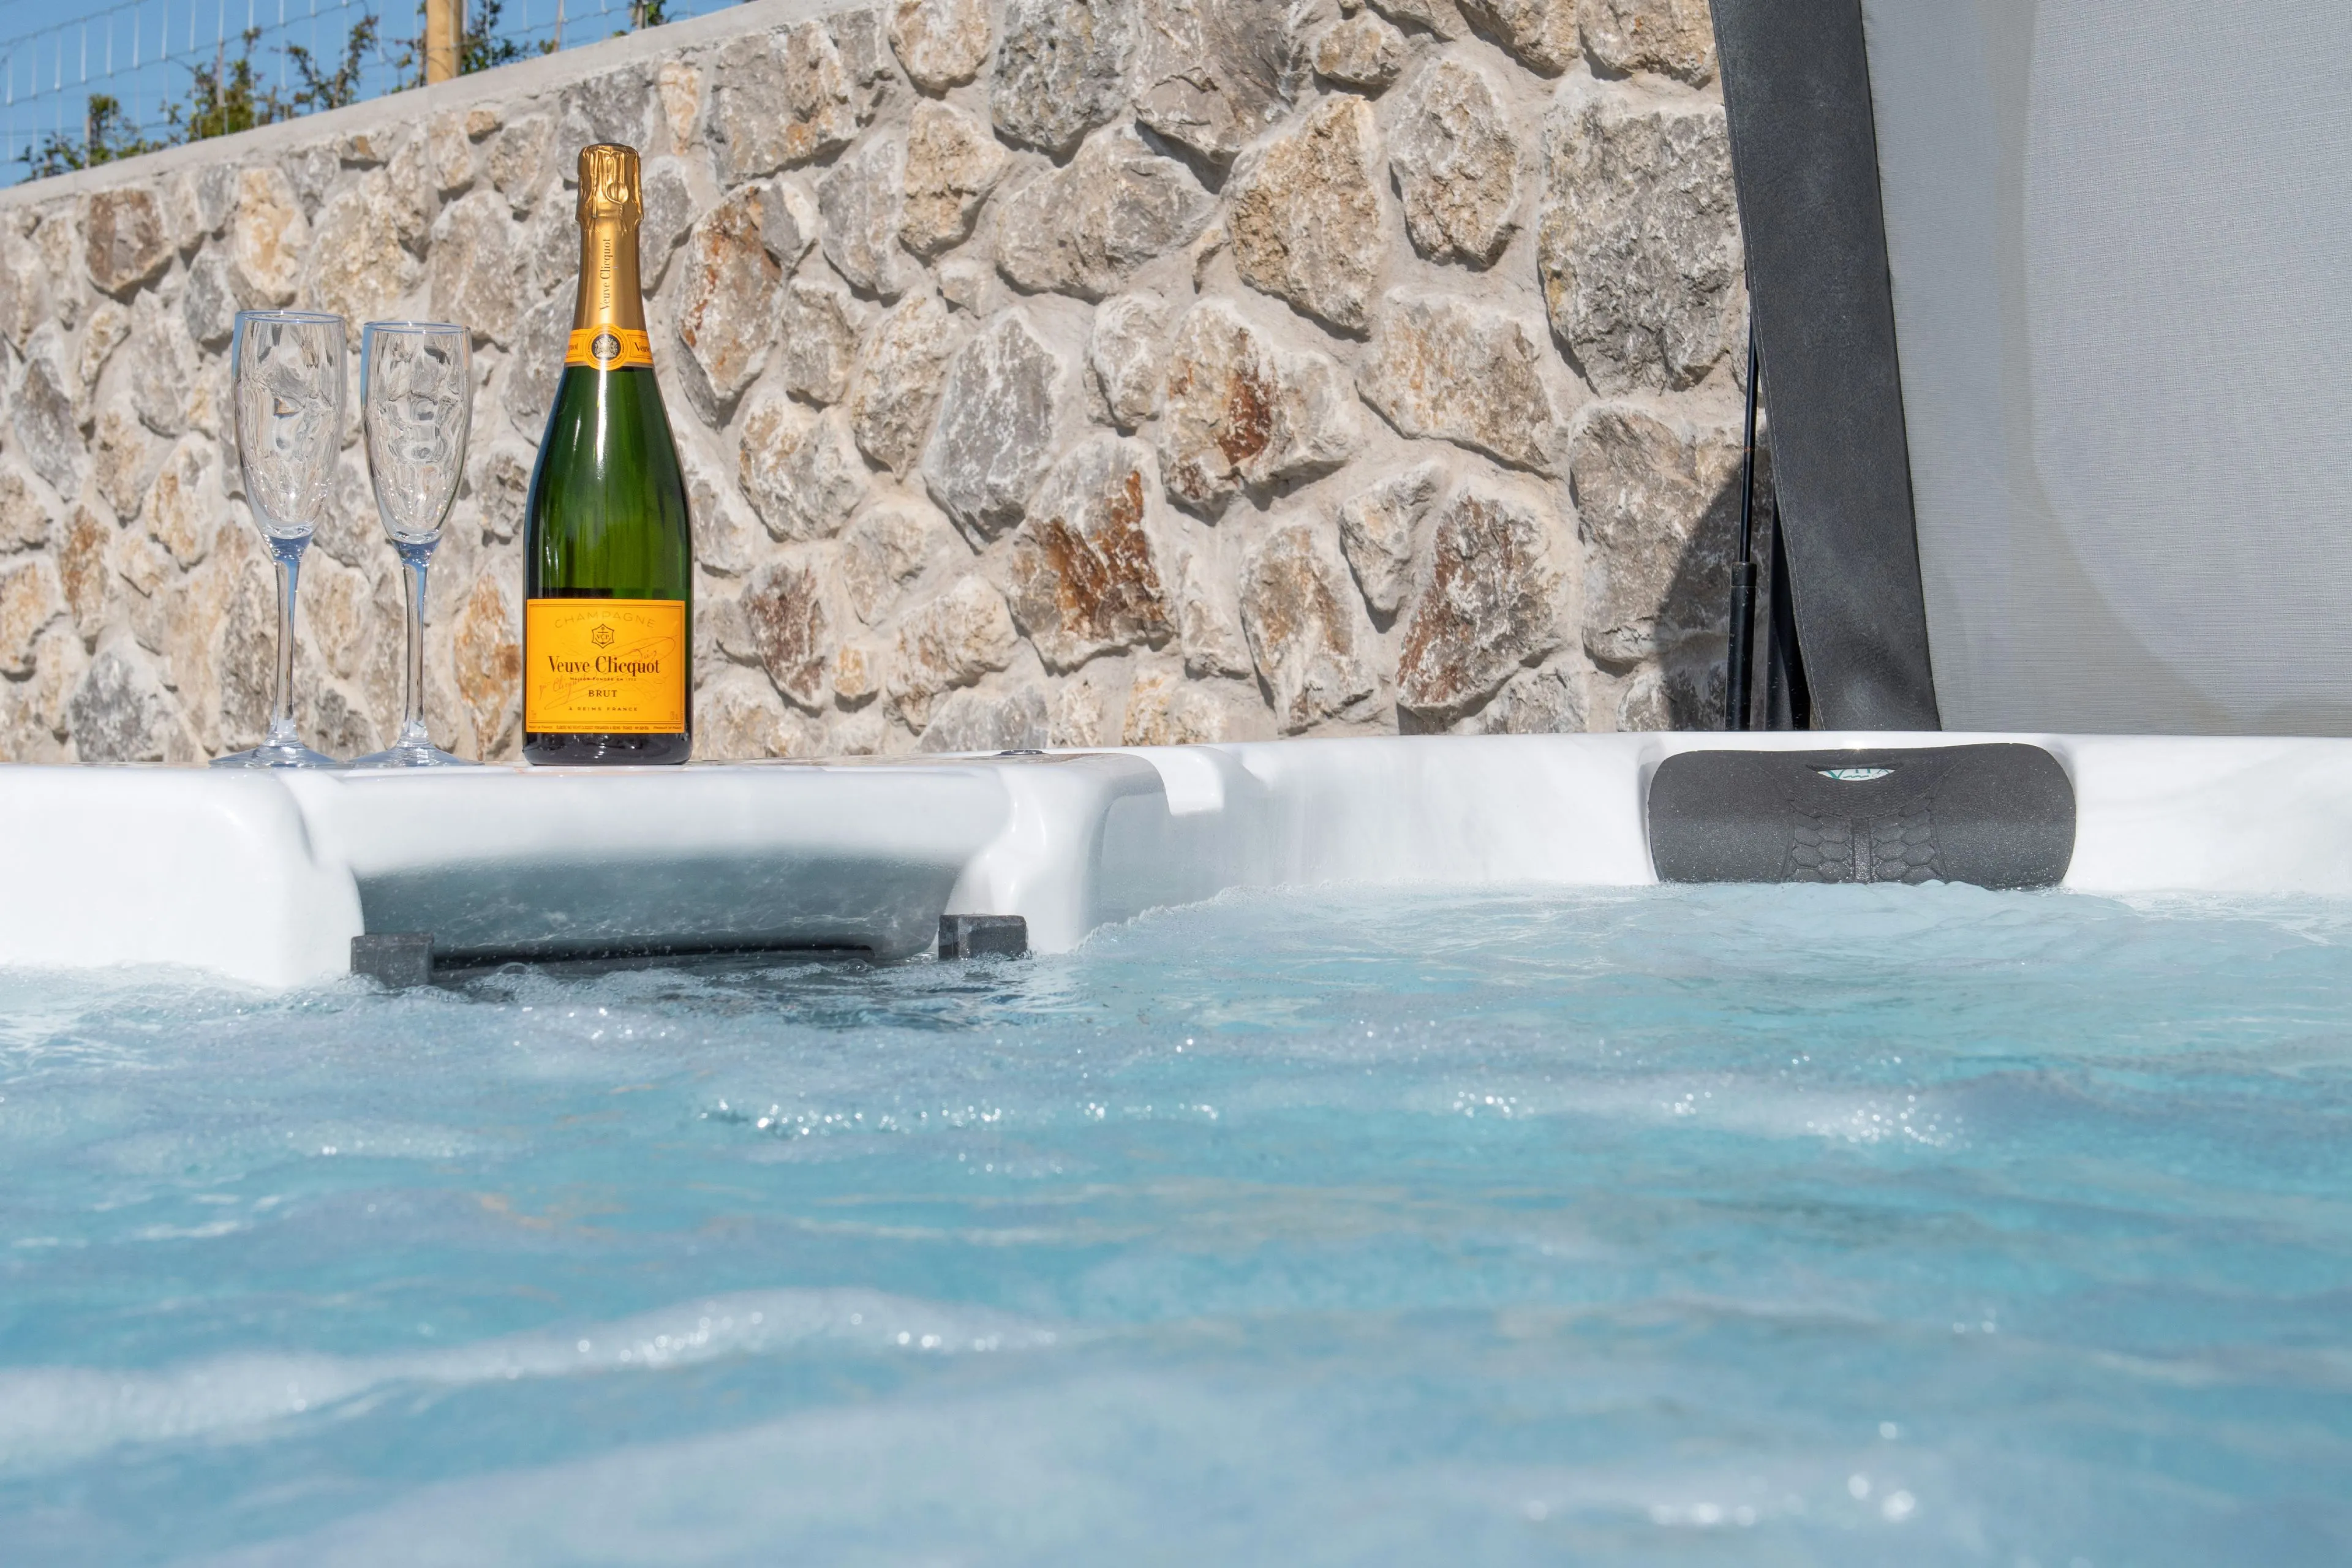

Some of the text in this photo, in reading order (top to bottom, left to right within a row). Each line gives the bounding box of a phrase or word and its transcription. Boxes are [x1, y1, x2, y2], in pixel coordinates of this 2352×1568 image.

[600, 239, 613, 311] Veuve Clicquot
[555, 611, 655, 628] CHAMPAGNE
[548, 655, 590, 673] Veuve
[595, 655, 660, 676] Clicquot
